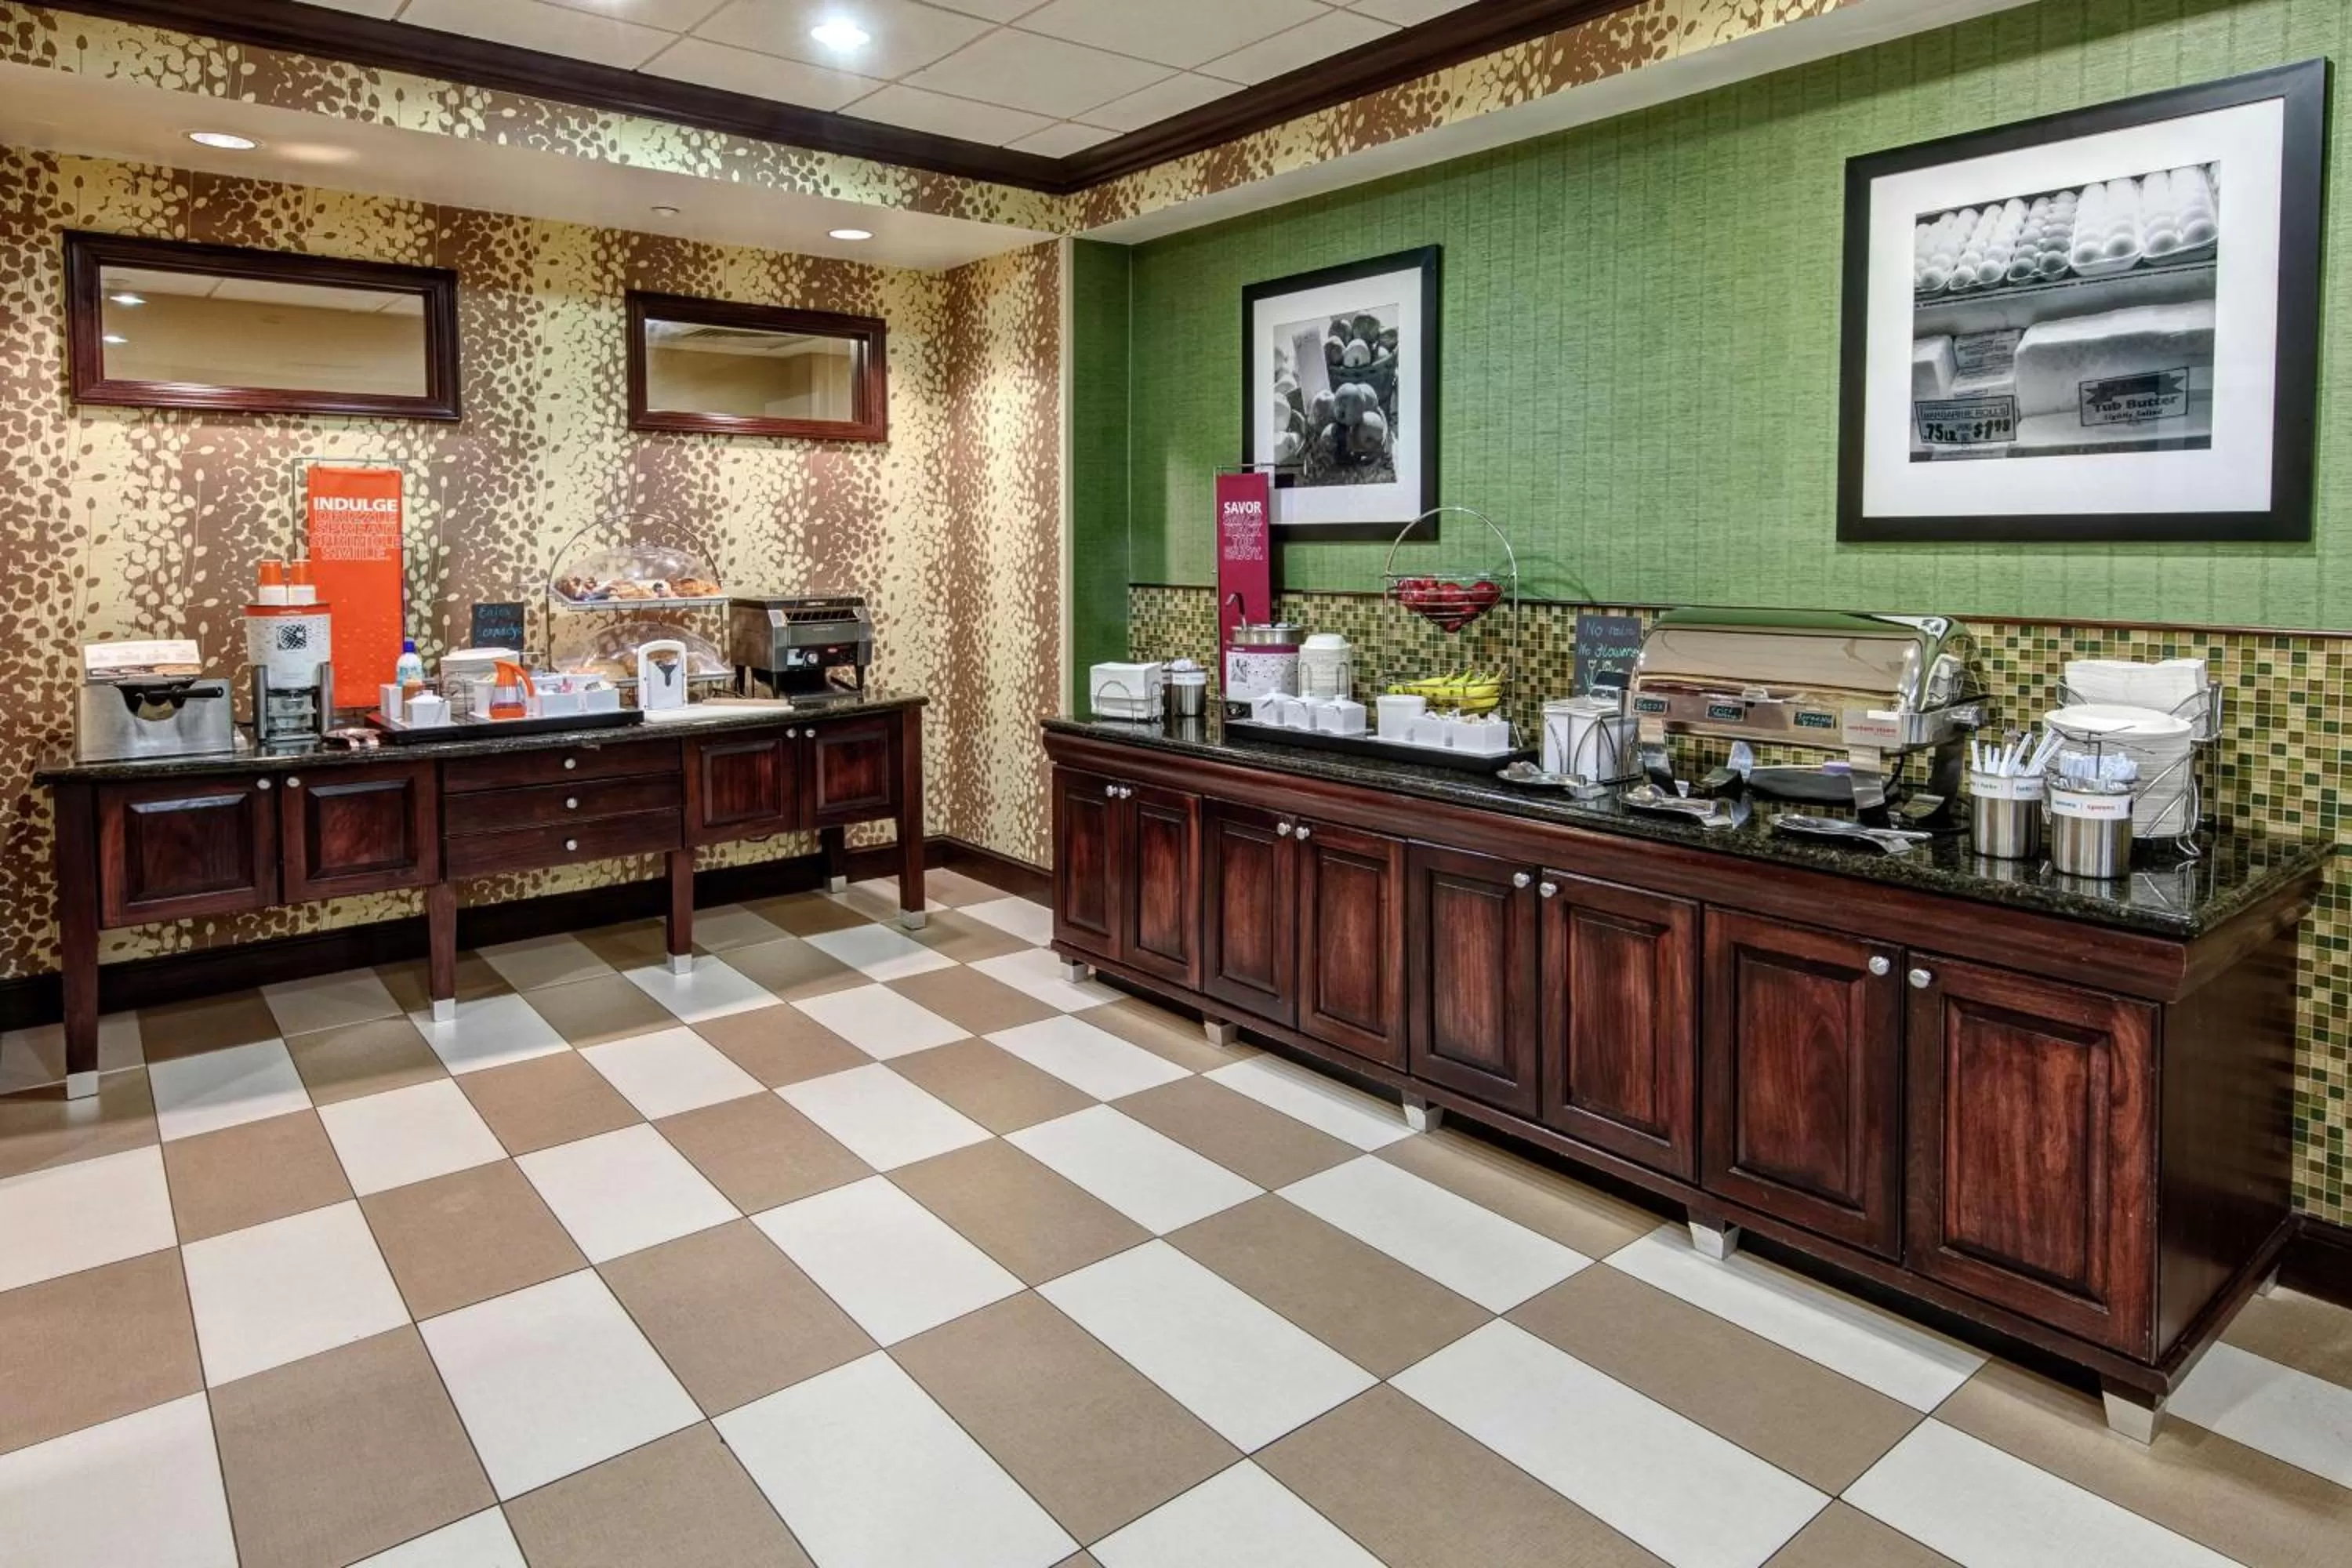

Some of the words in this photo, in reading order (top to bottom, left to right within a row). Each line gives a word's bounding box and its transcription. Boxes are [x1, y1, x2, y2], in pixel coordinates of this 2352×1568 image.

[2095, 401, 2122, 412] Tub
[2126, 395, 2179, 408] Butter
[313, 496, 398, 512] INDULGE
[1223, 501, 1261, 514] SAVOR
